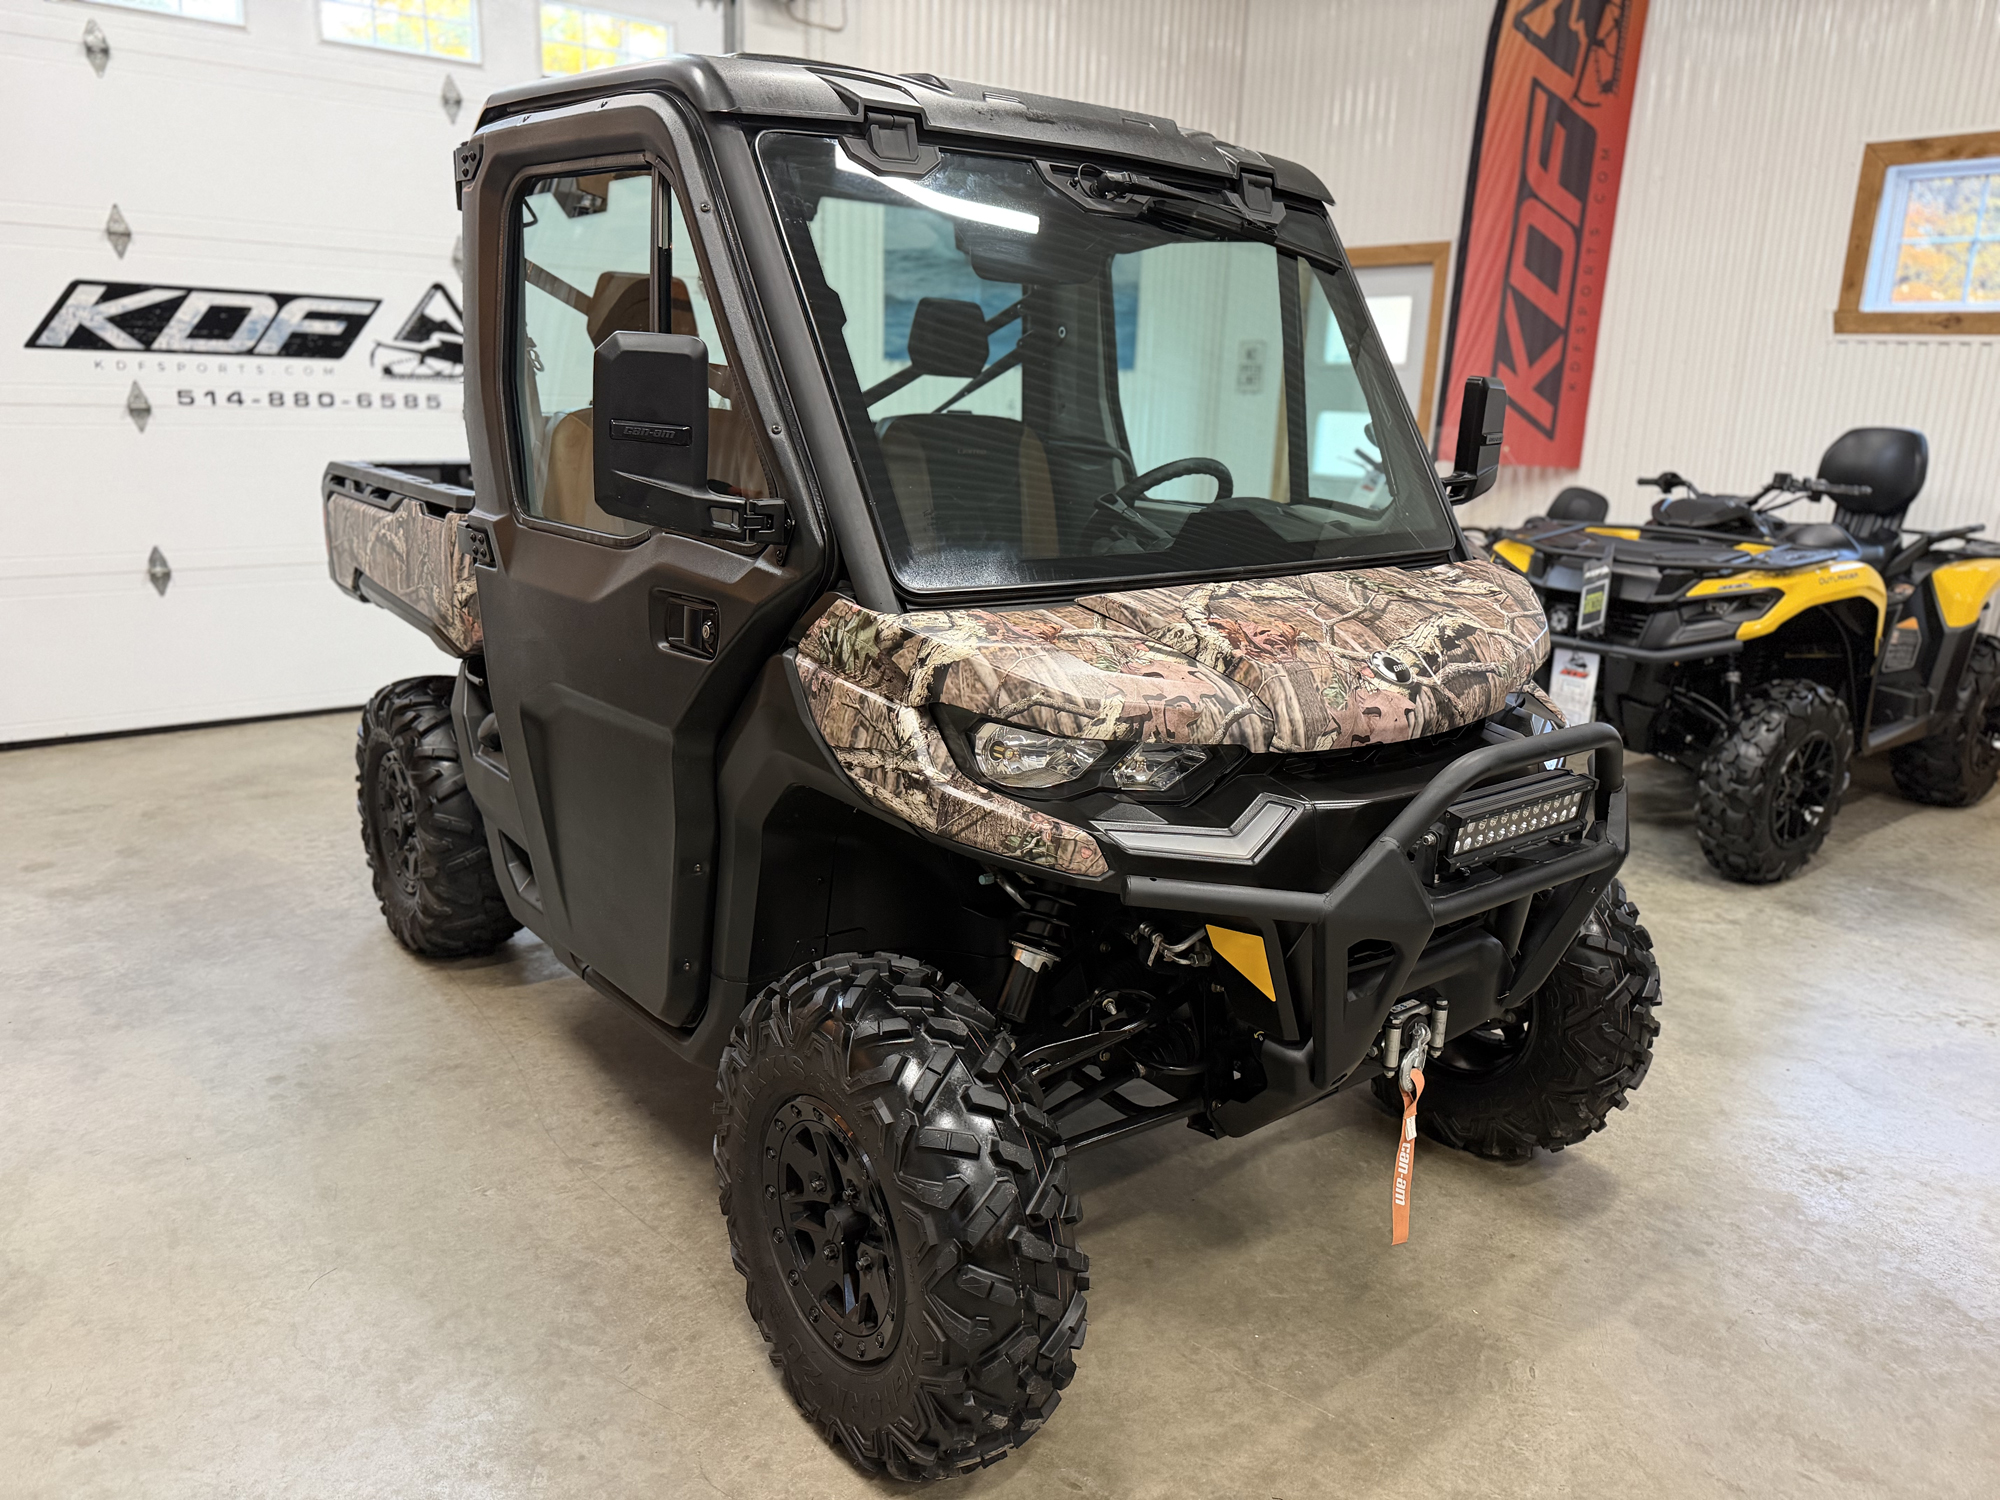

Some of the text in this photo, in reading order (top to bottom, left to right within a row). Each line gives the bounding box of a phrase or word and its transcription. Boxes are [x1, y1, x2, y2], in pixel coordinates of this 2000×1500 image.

[1496, 88, 1583, 430] KDF
[1567, 147, 1611, 392] KDFSPORTS.COM
[35, 284, 378, 356] KDF
[94, 359, 336, 376] KDFSPORTS.COM
[177, 389, 442, 410] 514-880-6585
[623, 426, 676, 438] can-am
[1395, 1142, 1410, 1206] can-am
